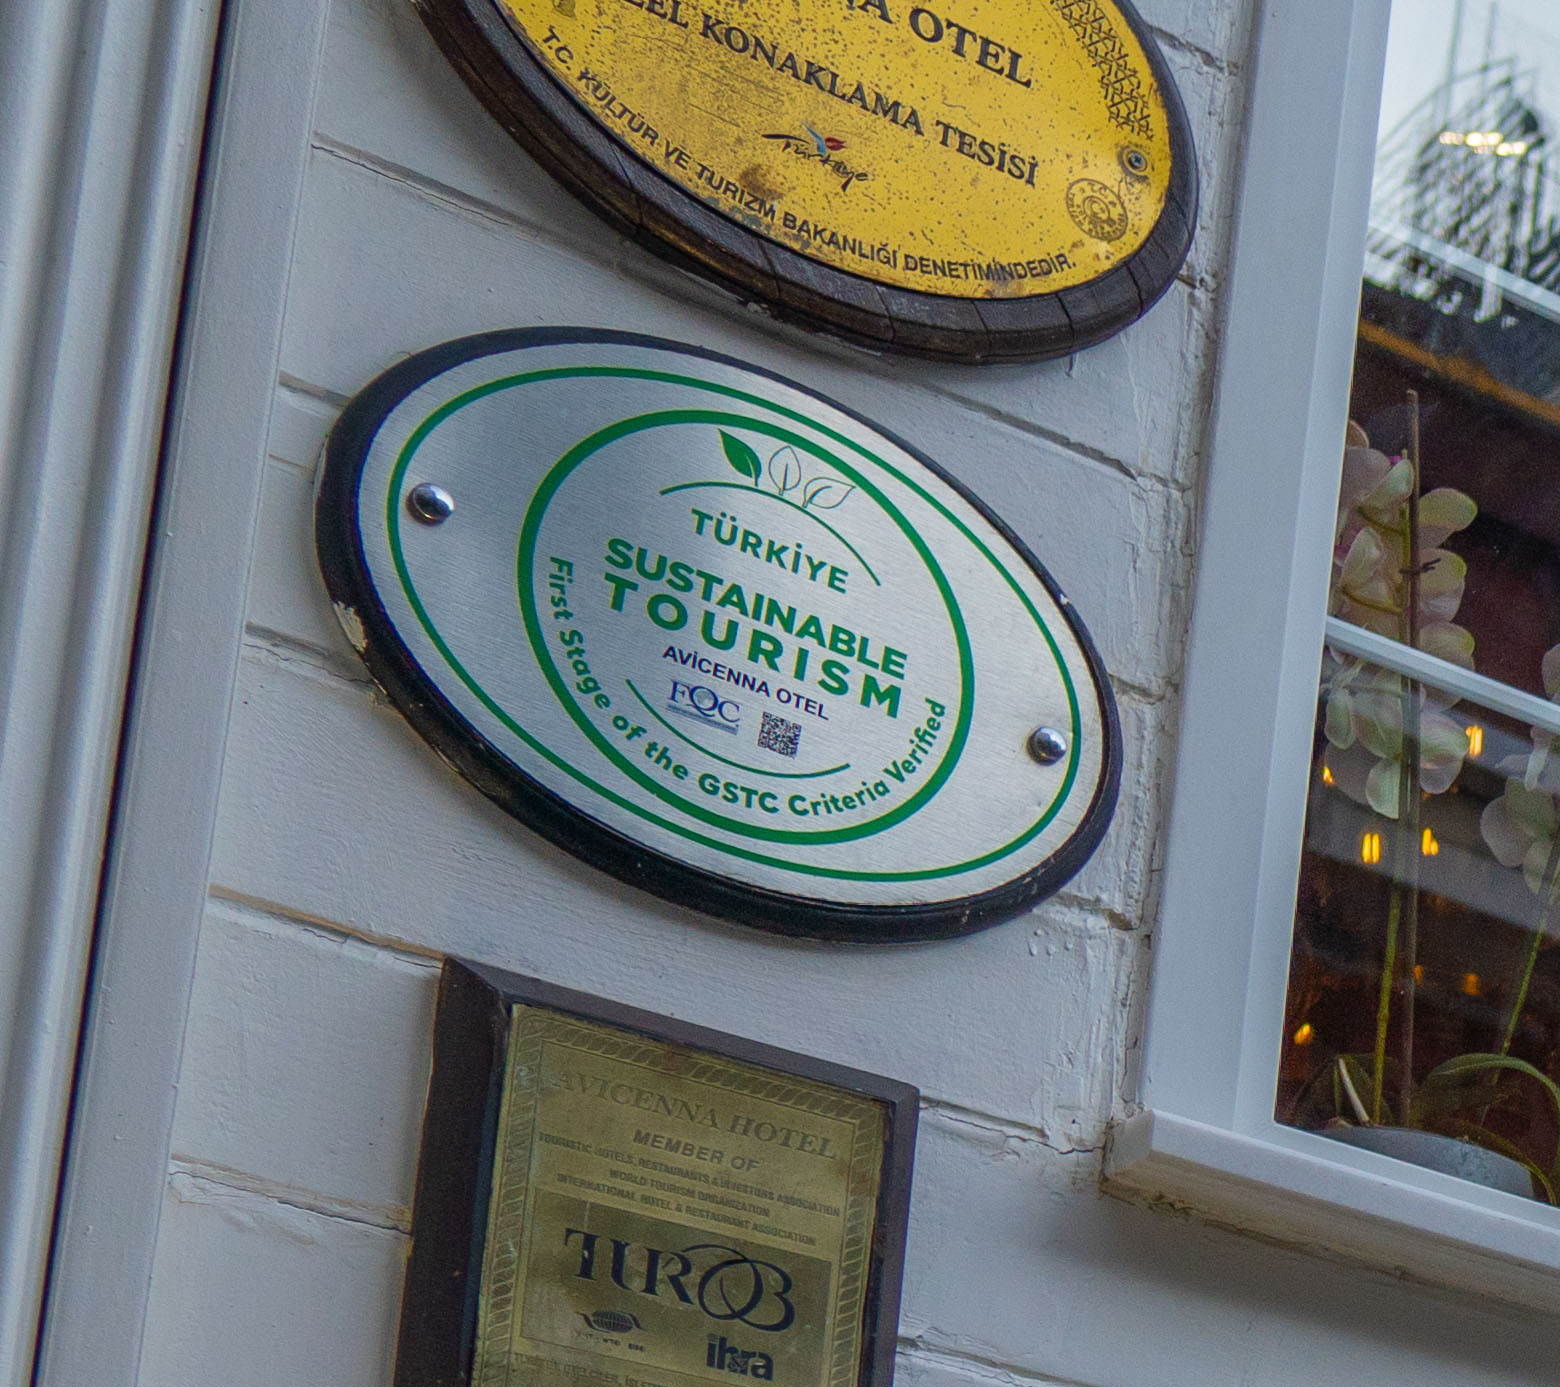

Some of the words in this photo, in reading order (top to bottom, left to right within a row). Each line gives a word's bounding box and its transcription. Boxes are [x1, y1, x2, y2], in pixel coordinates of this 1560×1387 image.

[908, 7, 1033, 89] OTEL
[542, 25, 575, 71] T.C.
[577, 68, 661, 147] KÜLTÜR
[663, 139, 694, 171] VE
[700, 12, 925, 137] KONAKLAMA
[936, 119, 1040, 189] TESİSİ
[548, 555, 575, 621] First
[690, 506, 850, 594] TÜRKİYE
[602, 571, 902, 719] TOURISM
[603, 536, 909, 681] SUSTAINABLE
[559, 628, 612, 709] Stage
[662, 645, 771, 698] AVİCENNA
[776, 687, 830, 721] OTEL
[667, 679, 741, 724] FQC
[611, 714, 648, 741] of
[643, 739, 689, 781] the
[882, 696, 947, 784] Verified
[697, 772, 780, 815] GSTC
[787, 779, 891, 817] Criteria
[552, 1070, 719, 1130] AVICENNA
[729, 1113, 837, 1161] HOTEL
[633, 1128, 723, 1166] MEMBER
[731, 1153, 760, 1175] OF
